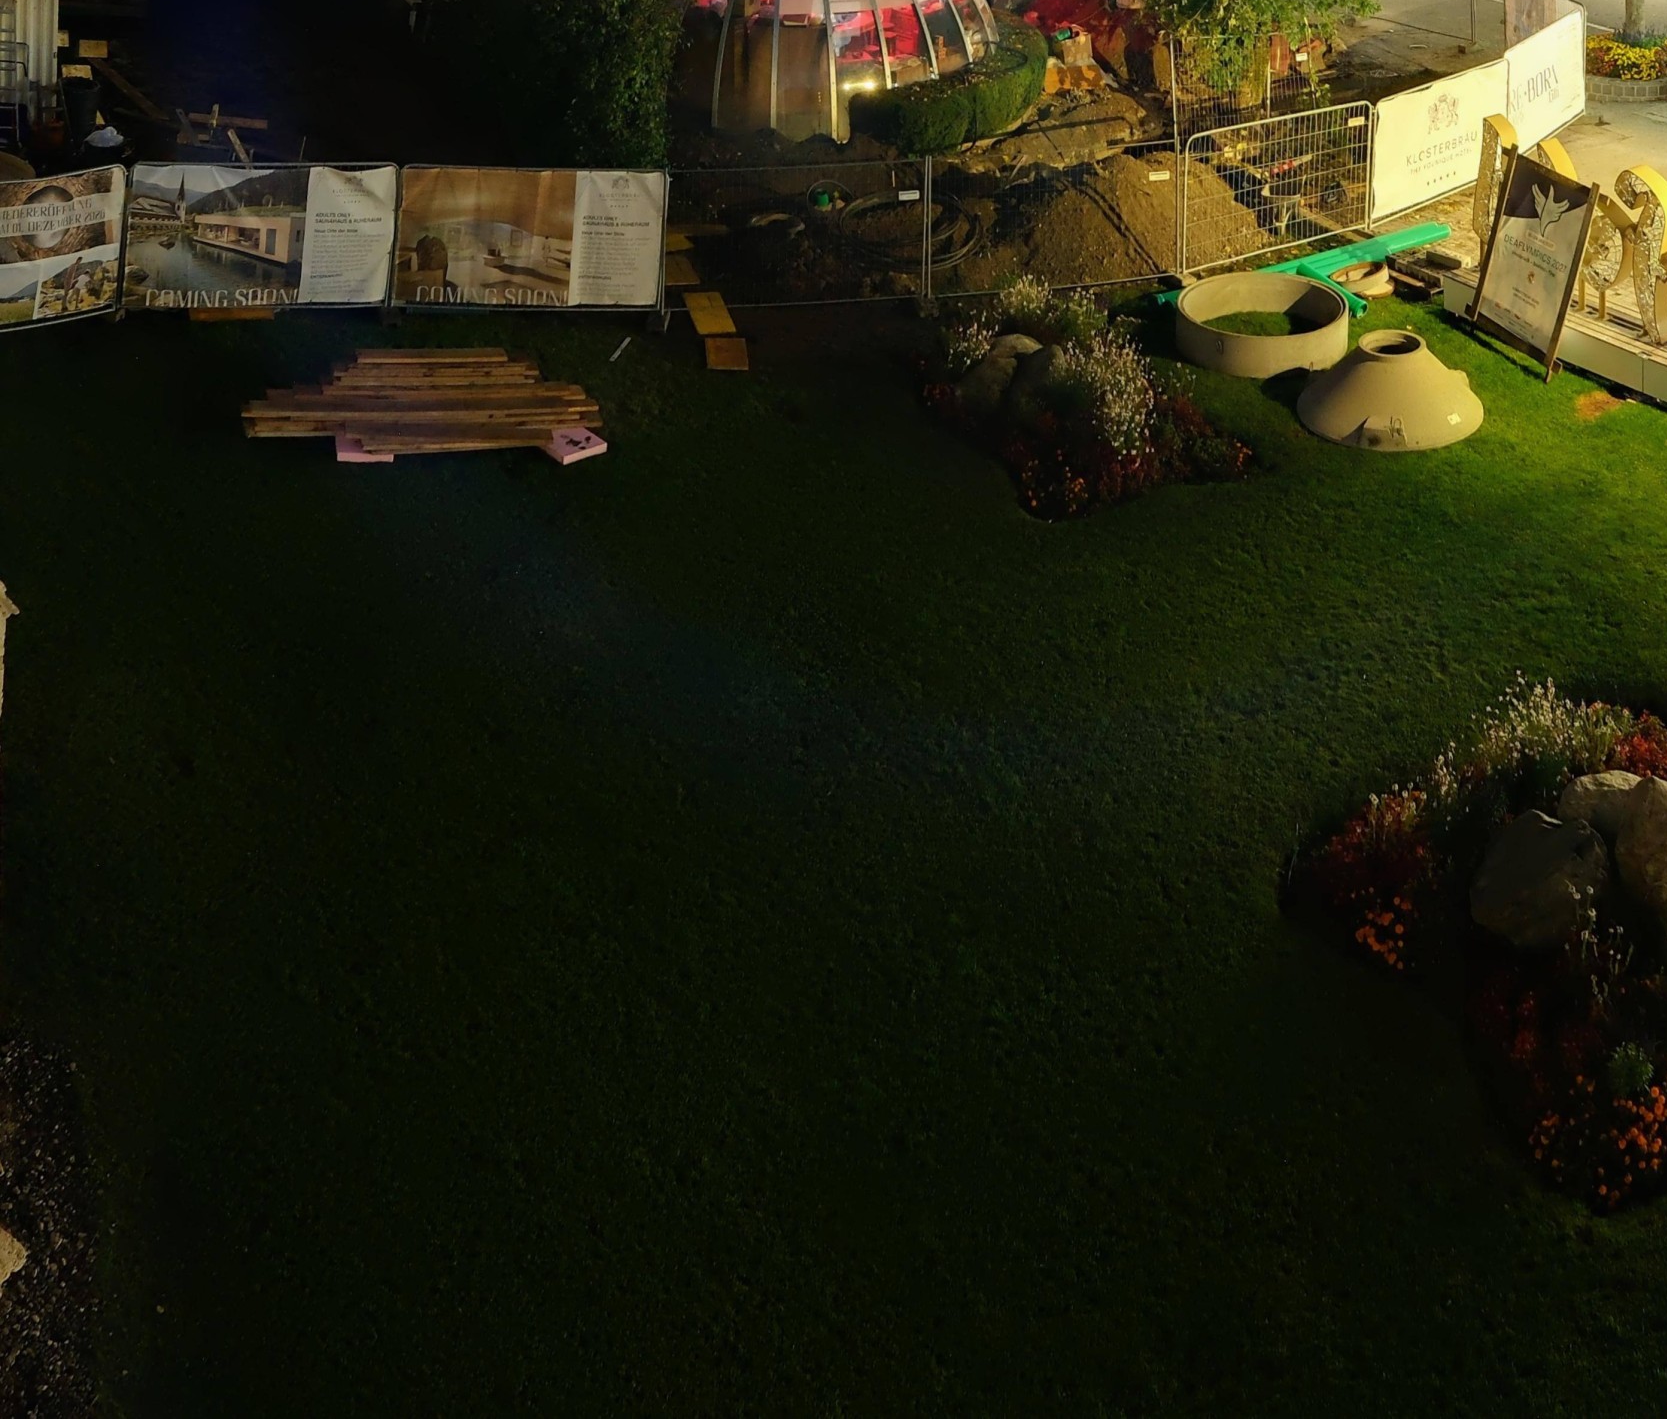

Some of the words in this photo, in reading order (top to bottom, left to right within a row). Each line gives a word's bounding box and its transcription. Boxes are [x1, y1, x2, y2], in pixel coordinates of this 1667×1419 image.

[146, 289, 228, 307] COMING
[234, 289, 300, 307] SOON!
[416, 285, 497, 304] COMING
[504, 289, 569, 307] SOON!
